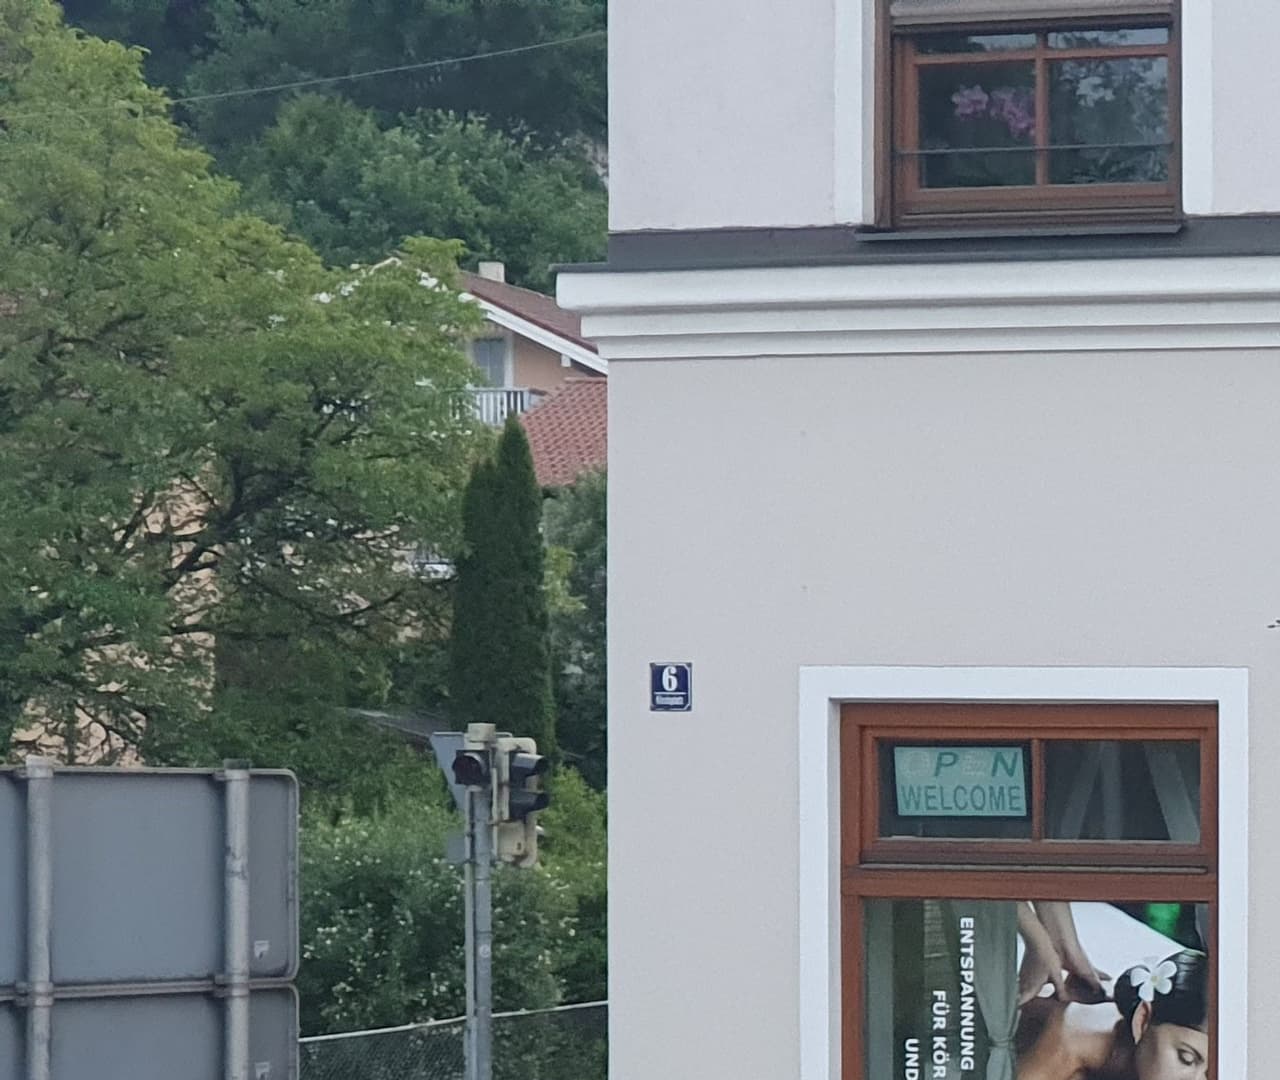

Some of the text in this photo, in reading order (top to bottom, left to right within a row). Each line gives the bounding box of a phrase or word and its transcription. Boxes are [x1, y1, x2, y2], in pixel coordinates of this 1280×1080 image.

[662, 665, 678, 691] 6
[900, 784, 1023, 811] WELCOME
[932, 990, 951, 1031] FÜR
[959, 916, 975, 1071] ENTSPANNUNG
